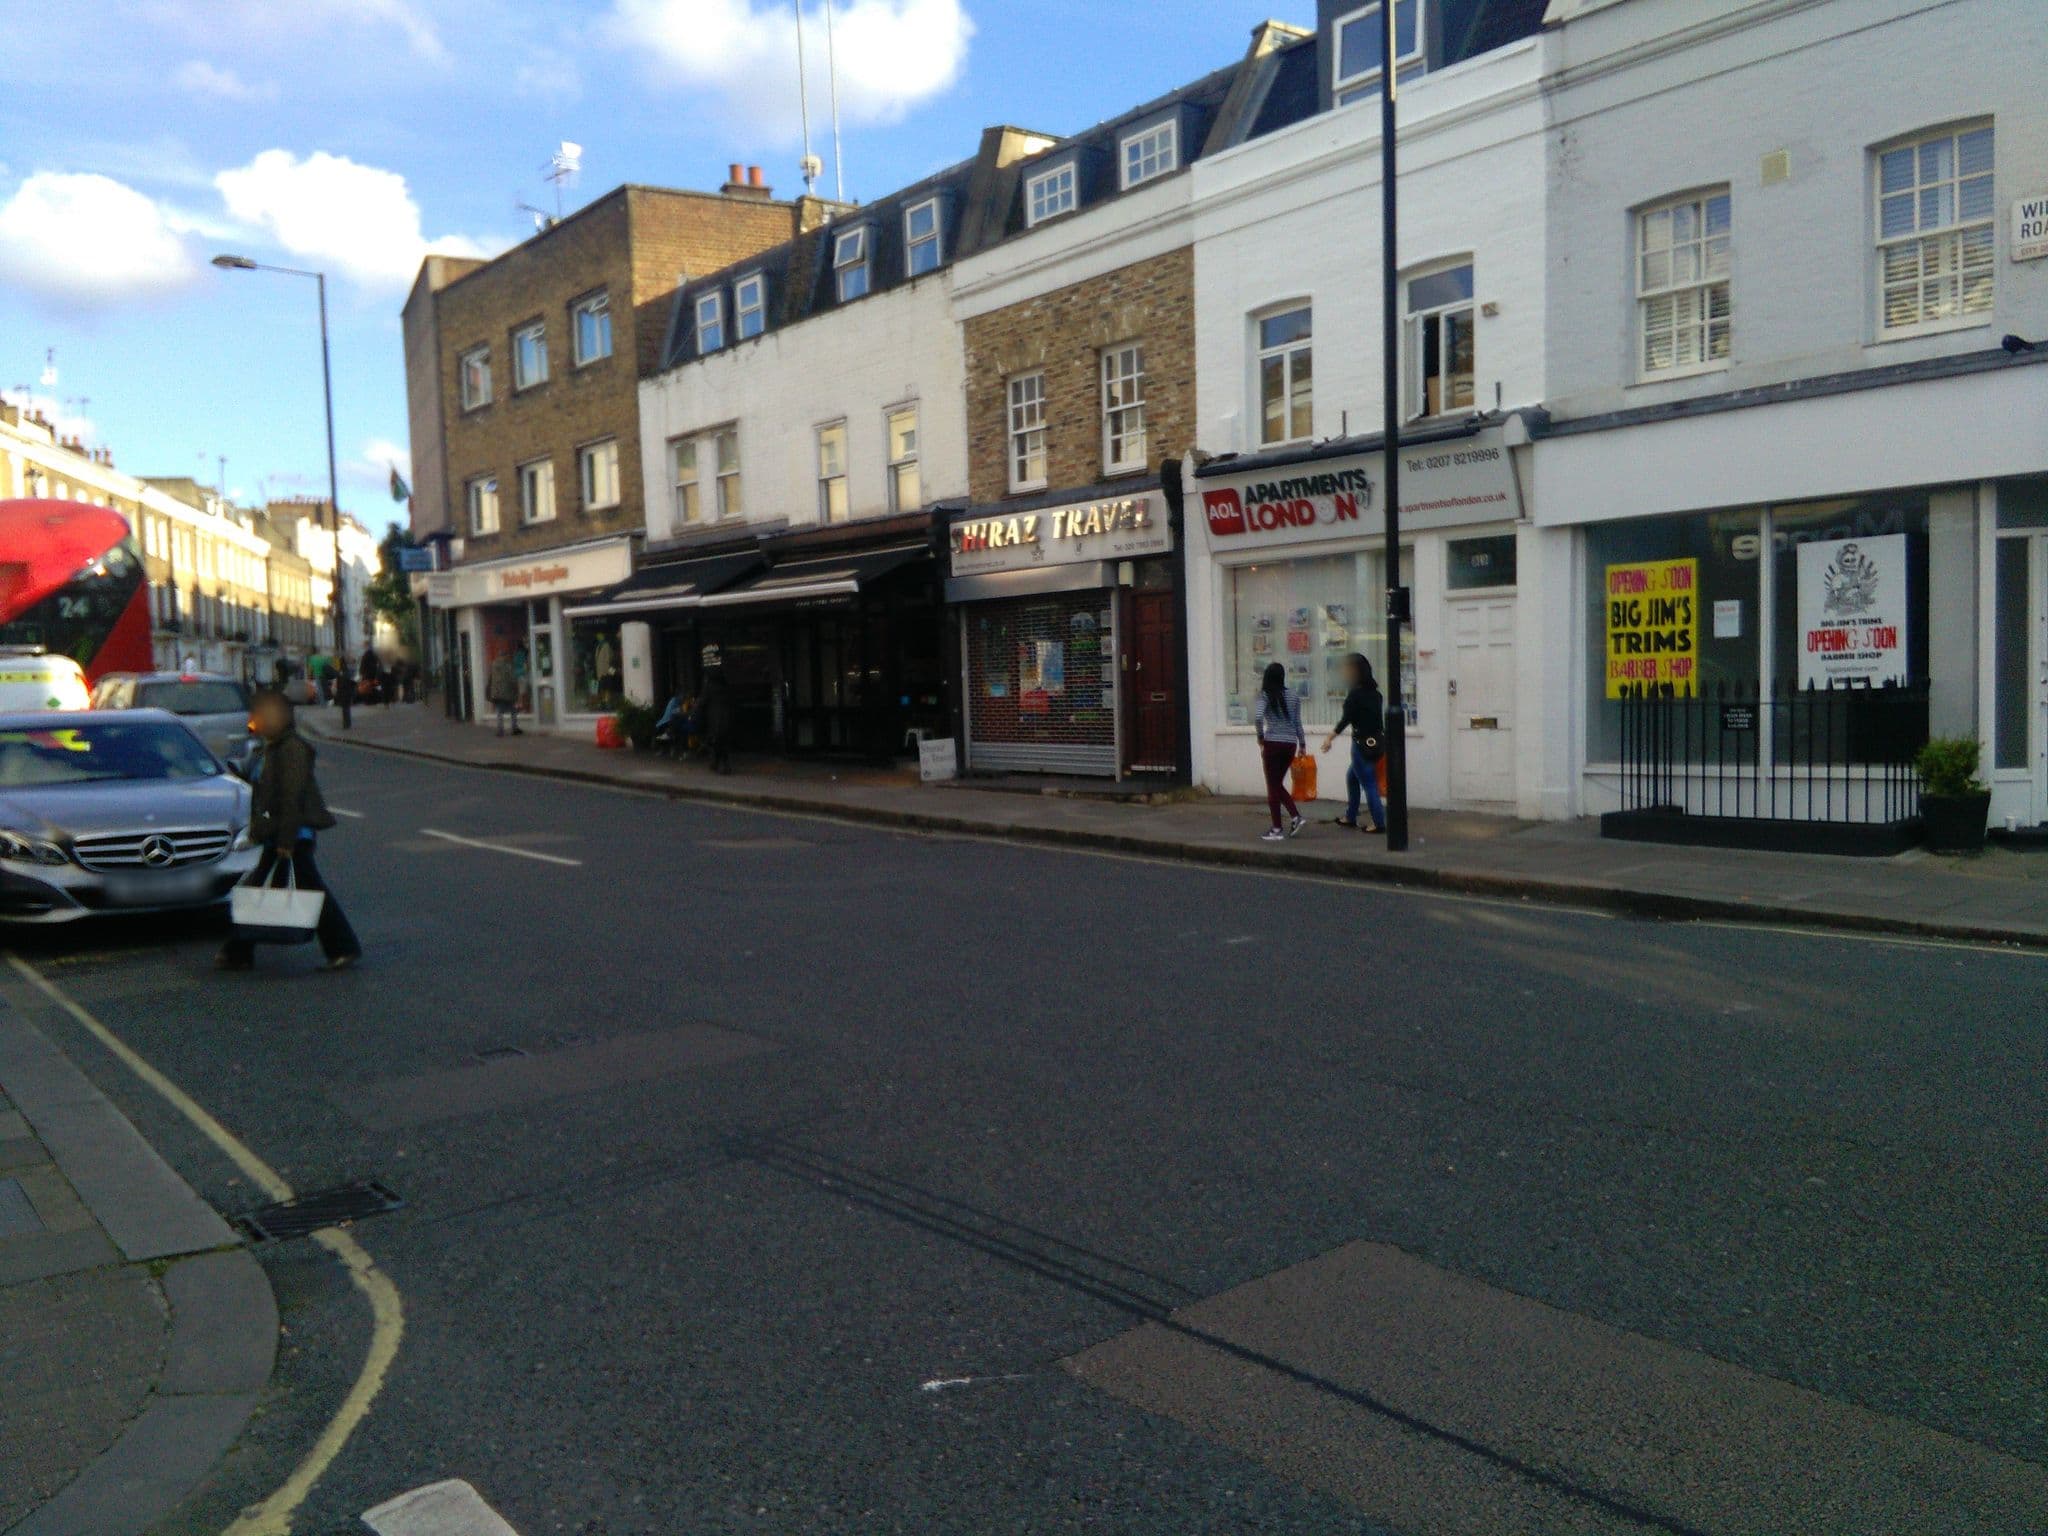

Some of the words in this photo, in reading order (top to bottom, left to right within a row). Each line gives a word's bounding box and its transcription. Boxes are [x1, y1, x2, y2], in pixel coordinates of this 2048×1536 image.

[1426, 456, 1450, 470] 0207
[1244, 468, 1368, 505] APARTMENTS
[1209, 503, 1240, 520] AOL
[1245, 493, 1358, 532] LONDON
[1383, 491, 1507, 514] .apartmentsoflondon.co.uk
[1052, 498, 1153, 538] TRAVEL
[1610, 569, 1656, 594] OPENING
[1661, 565, 1692, 590] SOON
[59, 596, 88, 618] 24
[1611, 599, 1642, 628] BIG
[1646, 596, 1691, 626] JIM'S
[1611, 629, 1691, 654] TRIMS
[1807, 628, 1857, 652] OPENING
[1862, 626, 1897, 650] SOON
[1610, 658, 1656, 680] BARBER
[1661, 657, 1692, 679] SHOP
[1820, 652, 1855, 661] BARBER
[1857, 651, 1882, 660] SHOP
